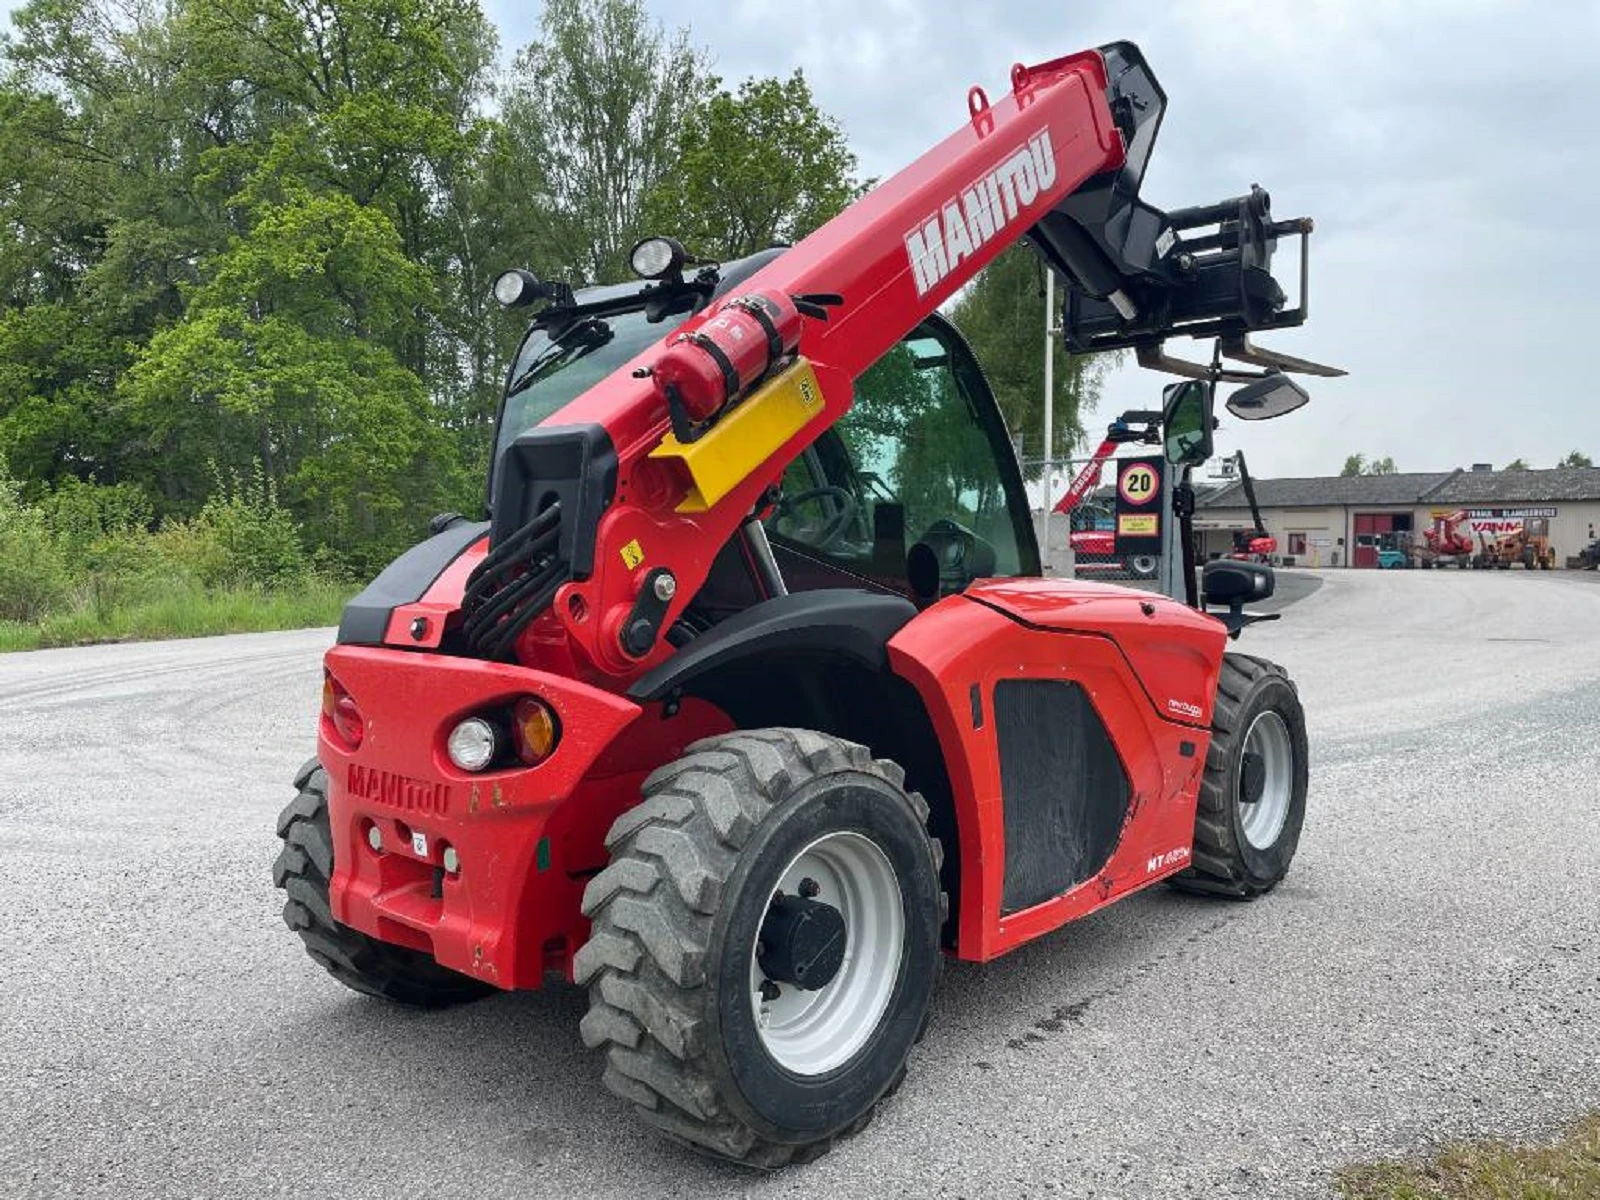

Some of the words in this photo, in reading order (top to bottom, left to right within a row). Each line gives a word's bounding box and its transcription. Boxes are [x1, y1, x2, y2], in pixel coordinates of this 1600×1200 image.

[906, 130, 1056, 297] MANITOU
[1128, 473, 1150, 492] 20
[347, 763, 452, 815] MANITOU
